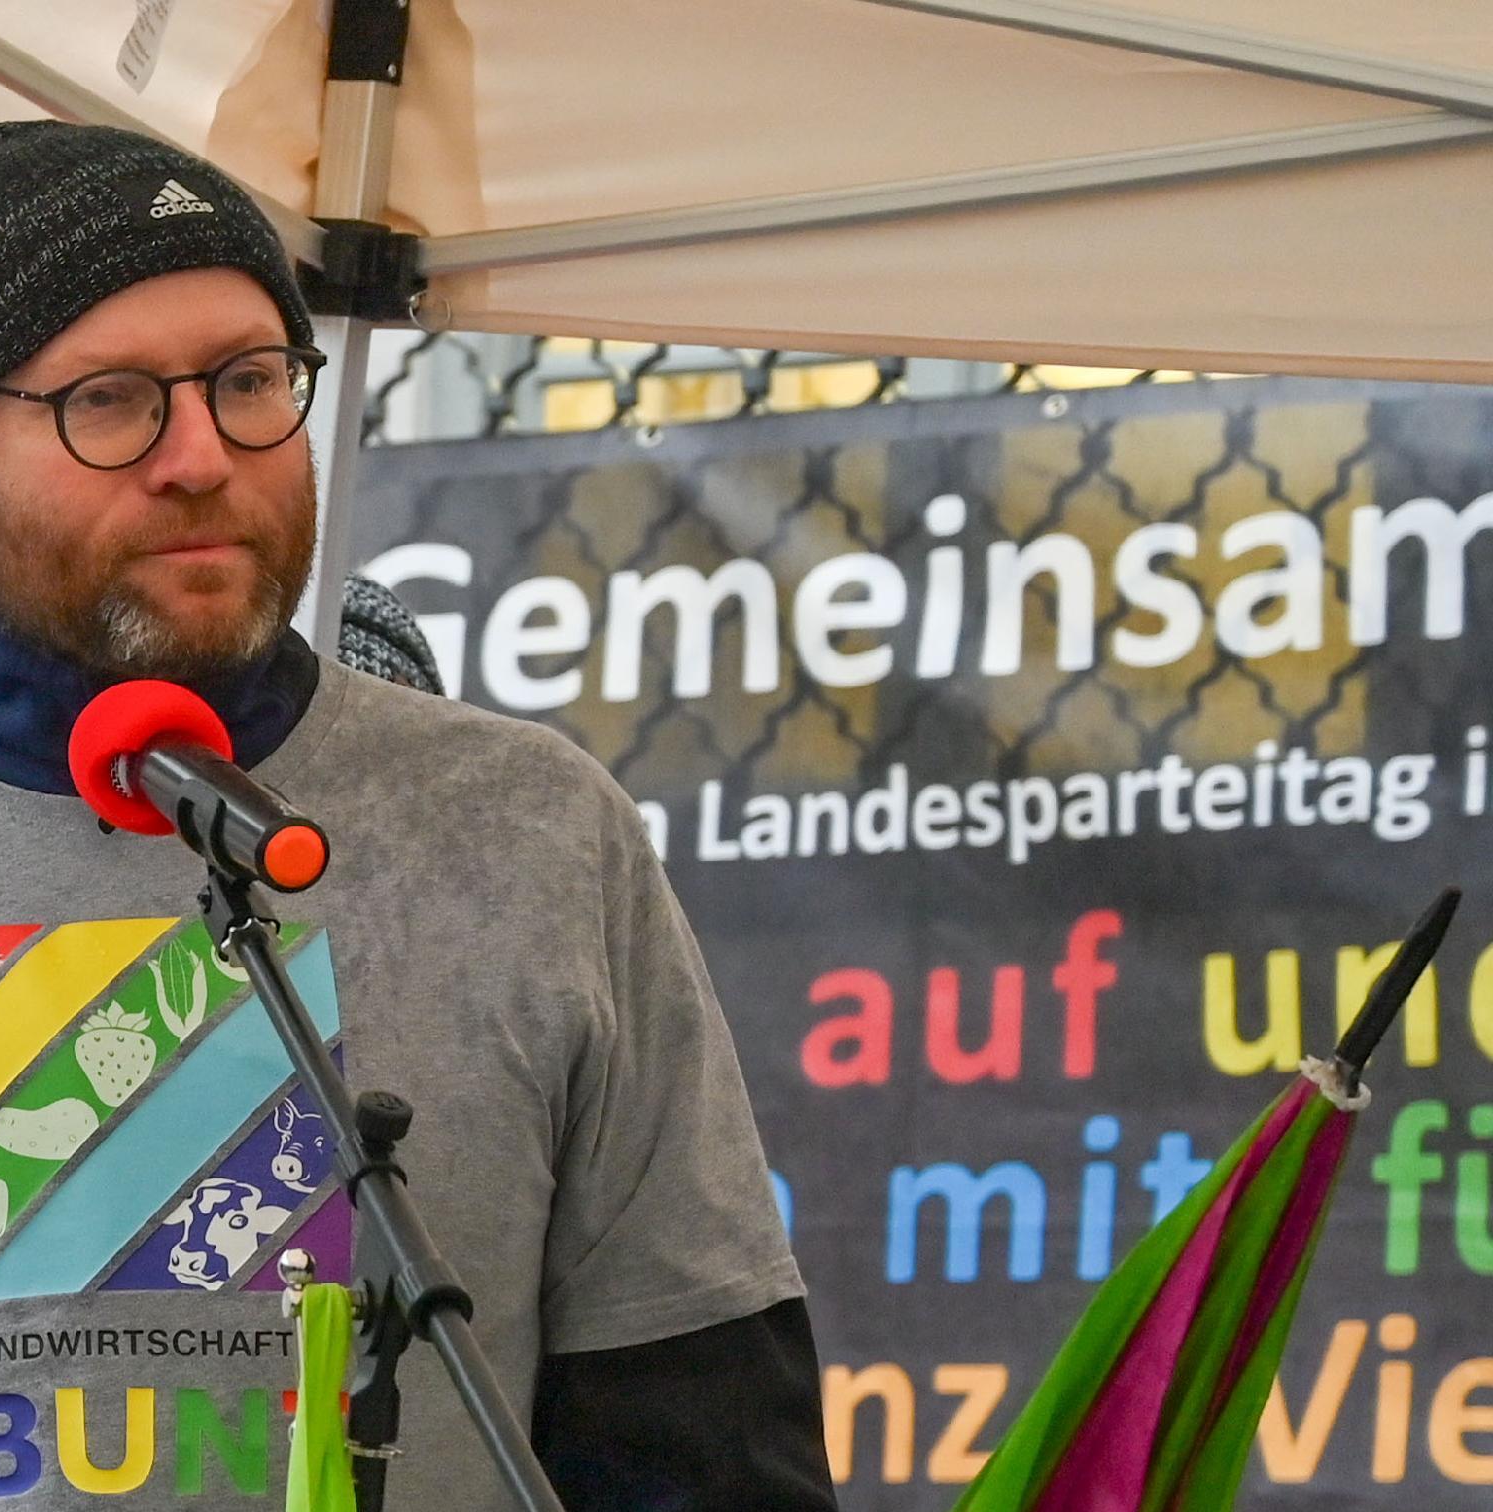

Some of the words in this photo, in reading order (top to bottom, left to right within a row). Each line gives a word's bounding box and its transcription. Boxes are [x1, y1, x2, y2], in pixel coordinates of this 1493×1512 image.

[149, 200, 214, 219] adidas
[362, 490, 1493, 713] Gemeinsam
[697, 739, 1436, 865] Landesparteitag
[801, 907, 1125, 1088] auf
[884, 1114, 1215, 1284] mit
[820, 1362, 1009, 1485] nz
